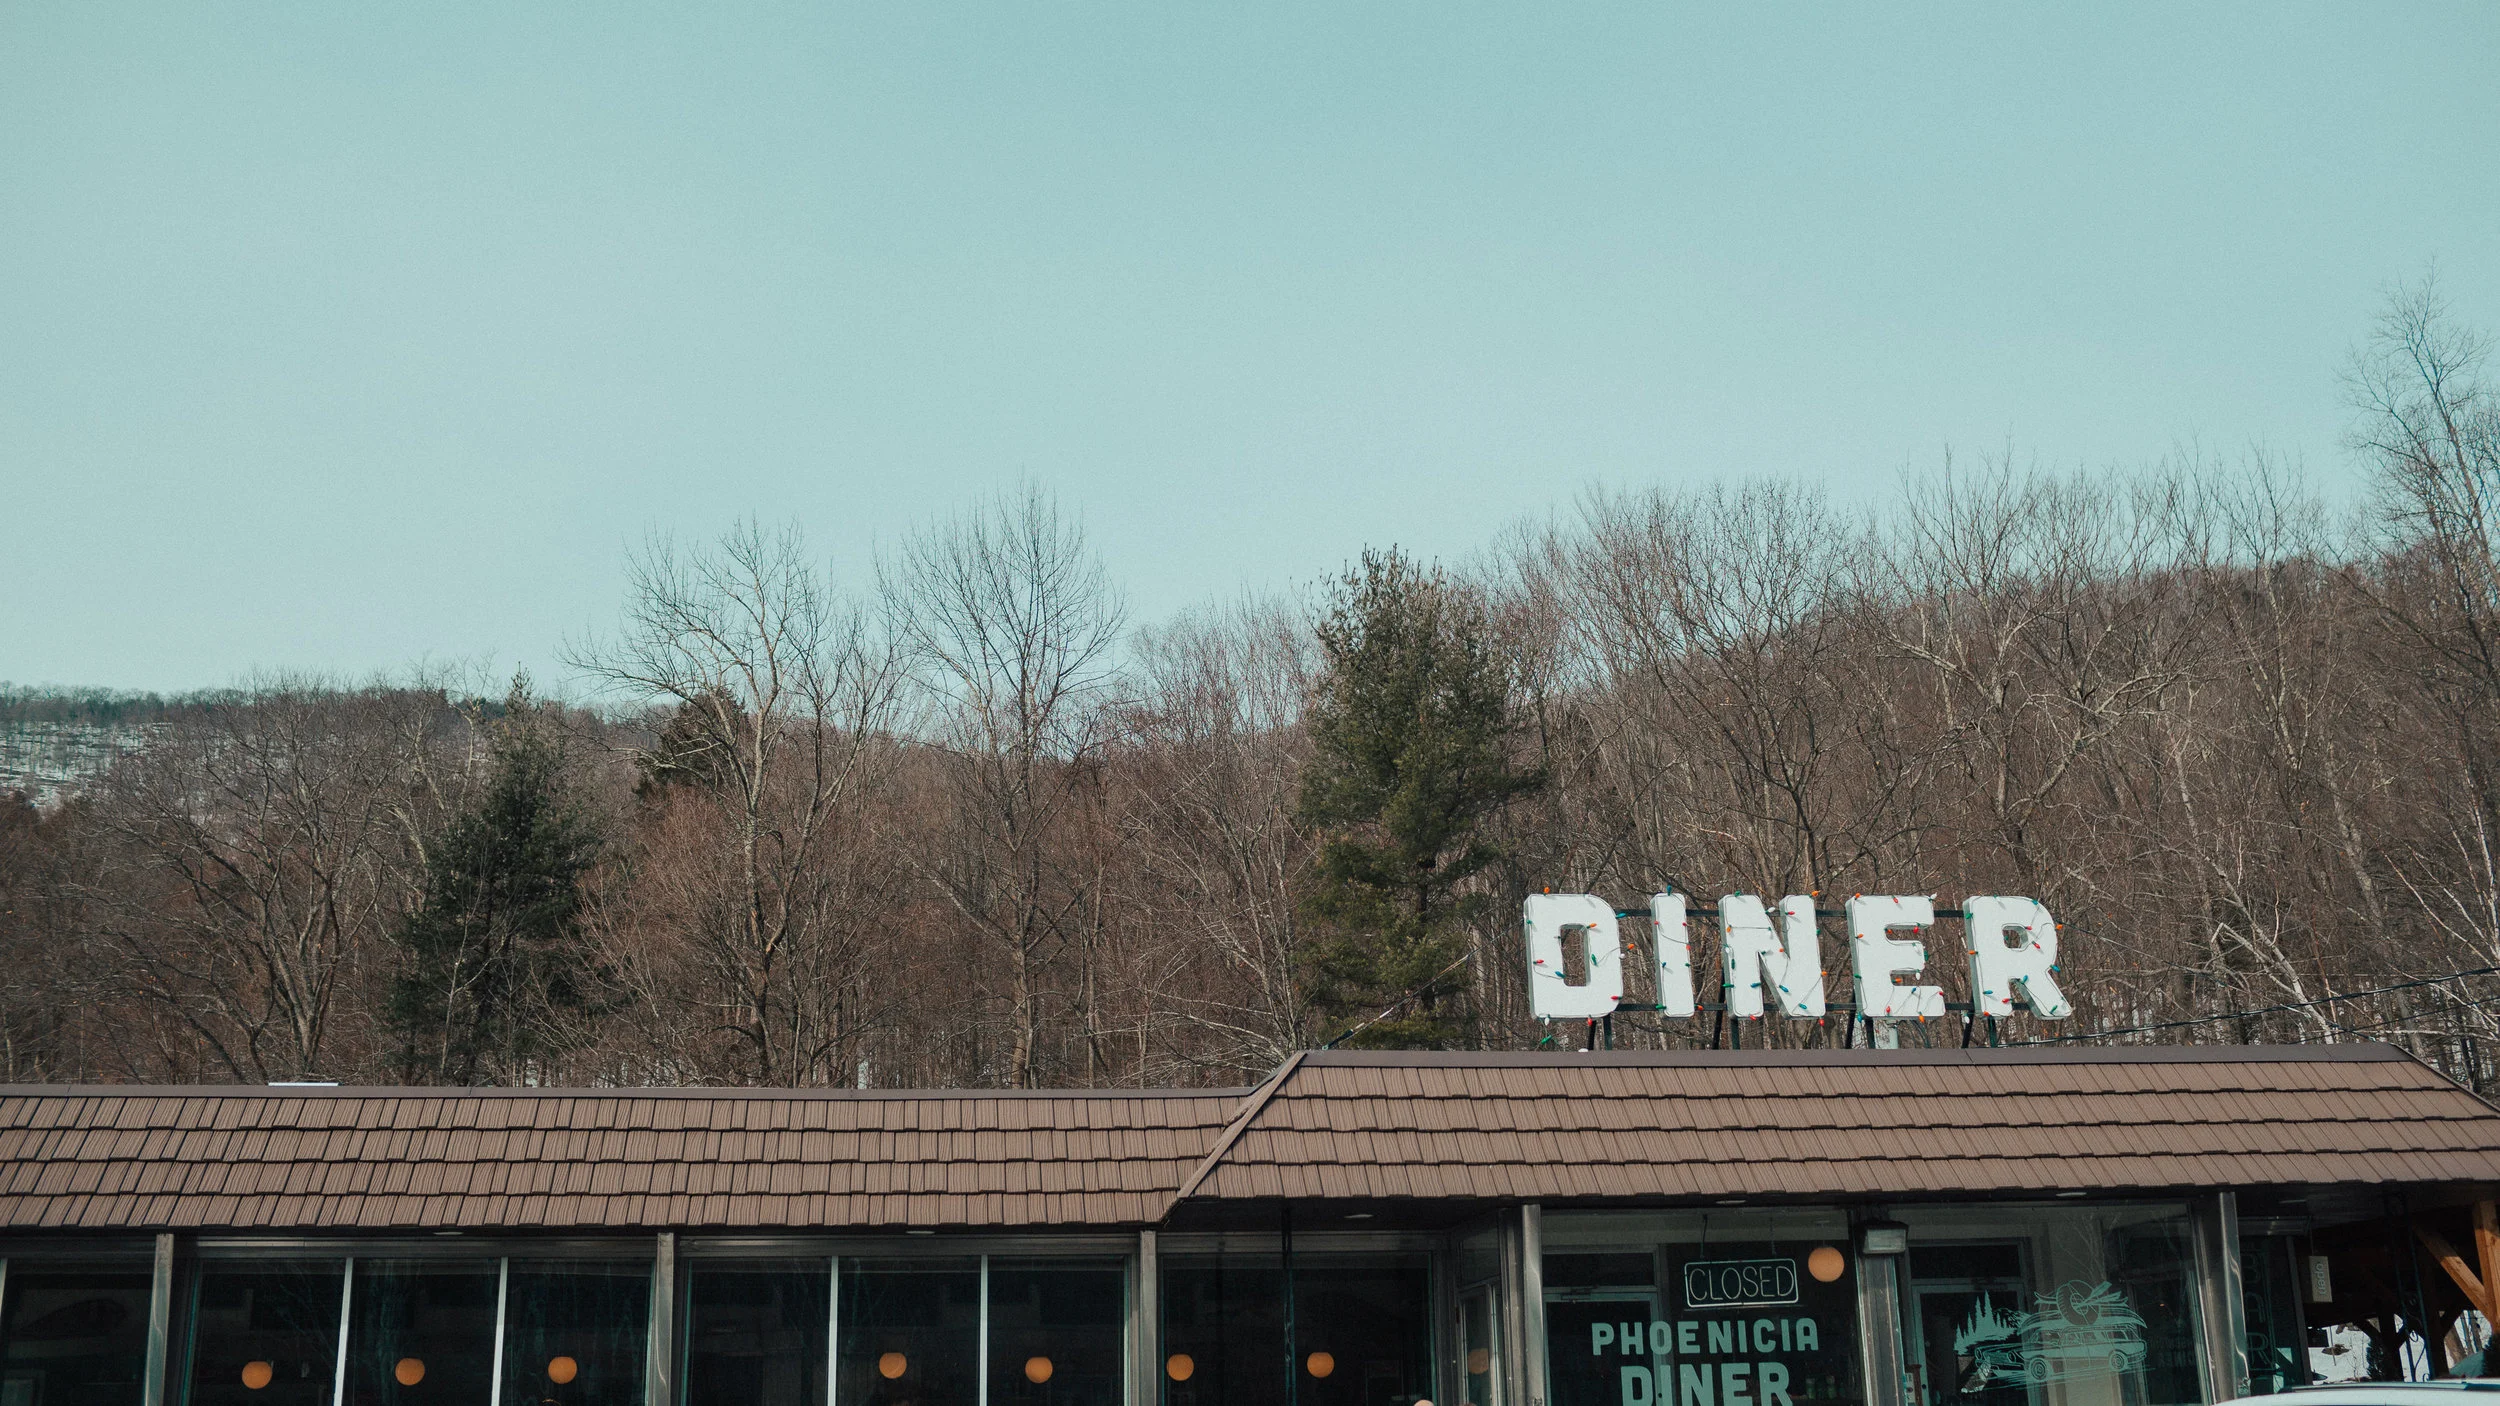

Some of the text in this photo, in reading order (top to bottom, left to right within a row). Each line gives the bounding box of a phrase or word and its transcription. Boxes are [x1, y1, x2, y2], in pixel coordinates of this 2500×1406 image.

[1523, 892, 2073, 1021] DINER
[1689, 1265, 1795, 1300] CLOSED
[1591, 1317, 1819, 1356] PHOENICIA
[1620, 1362, 1793, 1406] DINER
